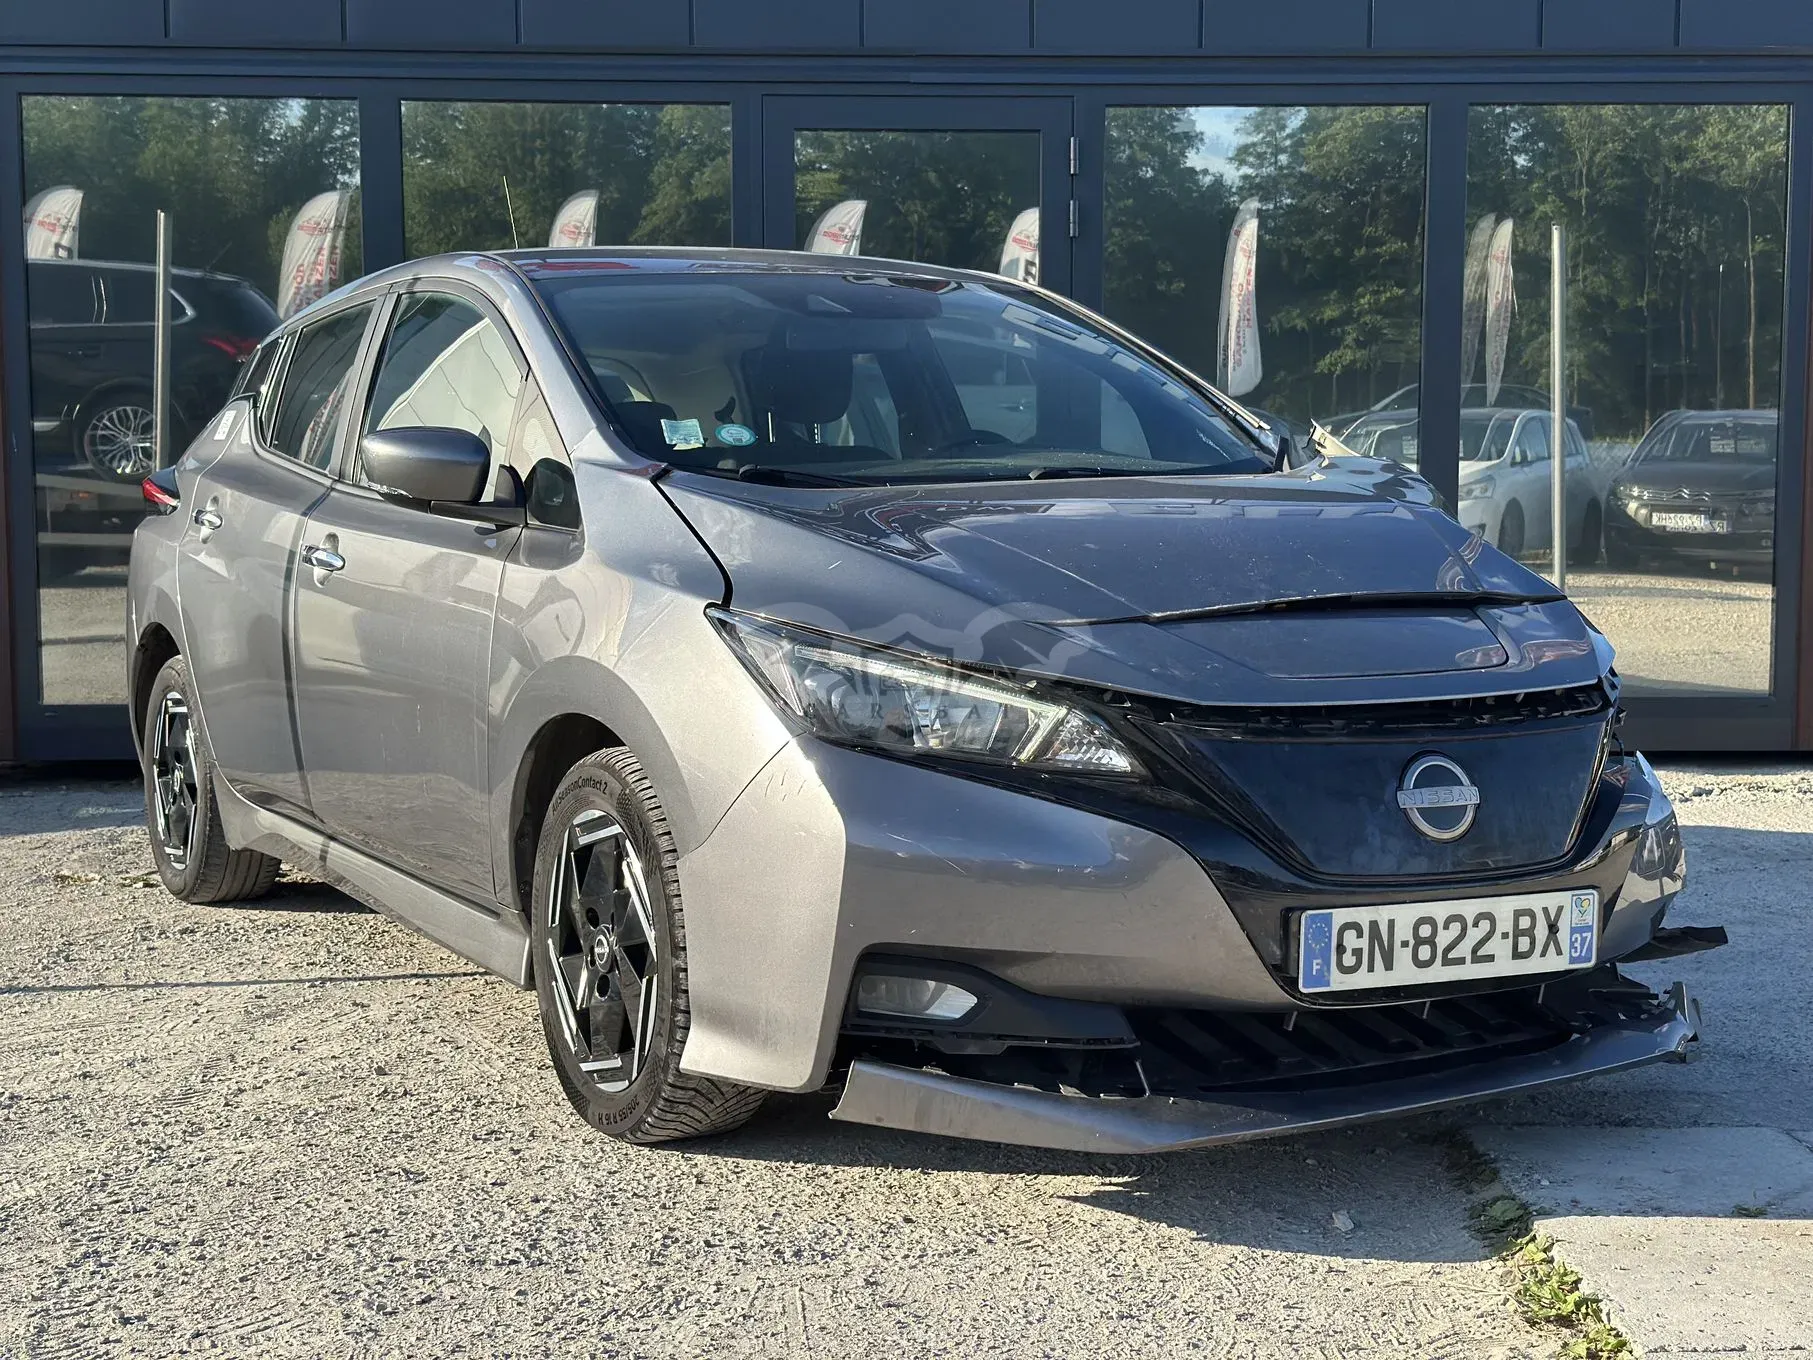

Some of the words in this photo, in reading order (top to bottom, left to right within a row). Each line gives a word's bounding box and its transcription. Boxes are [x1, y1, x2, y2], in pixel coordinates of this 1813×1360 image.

[1400, 787, 1479, 806] NISSAN
[1335, 905, 1564, 975] GN-822-BX
[1571, 932, 1592, 957] 37
[1312, 959, 1322, 976] F
